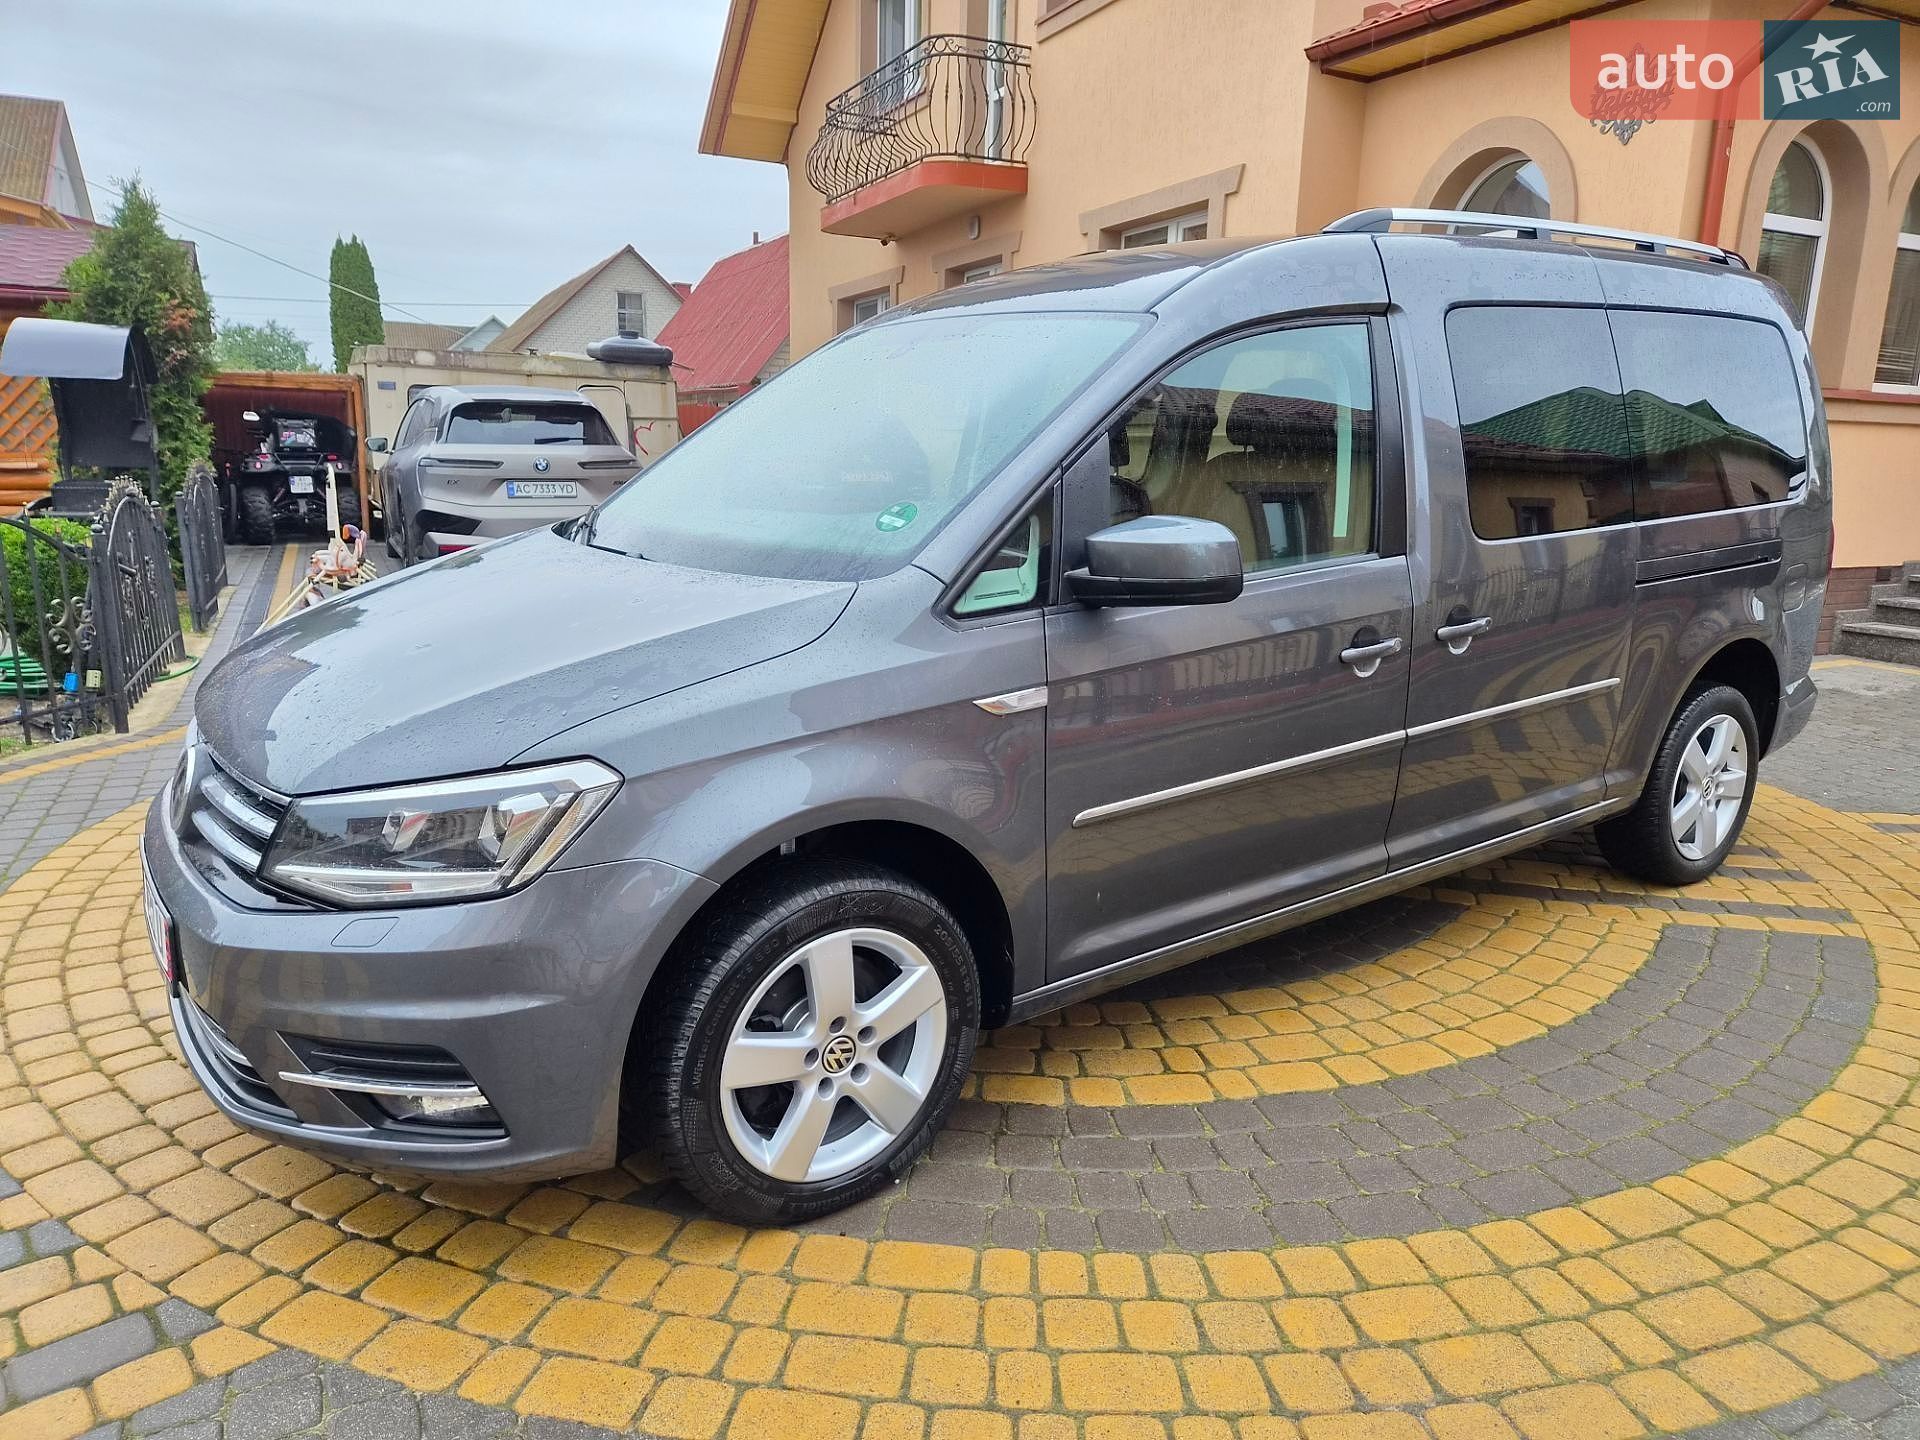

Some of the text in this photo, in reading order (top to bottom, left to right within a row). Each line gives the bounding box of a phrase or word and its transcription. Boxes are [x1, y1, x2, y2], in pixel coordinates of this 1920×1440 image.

[515, 483, 574, 494] AC 7333 YD
